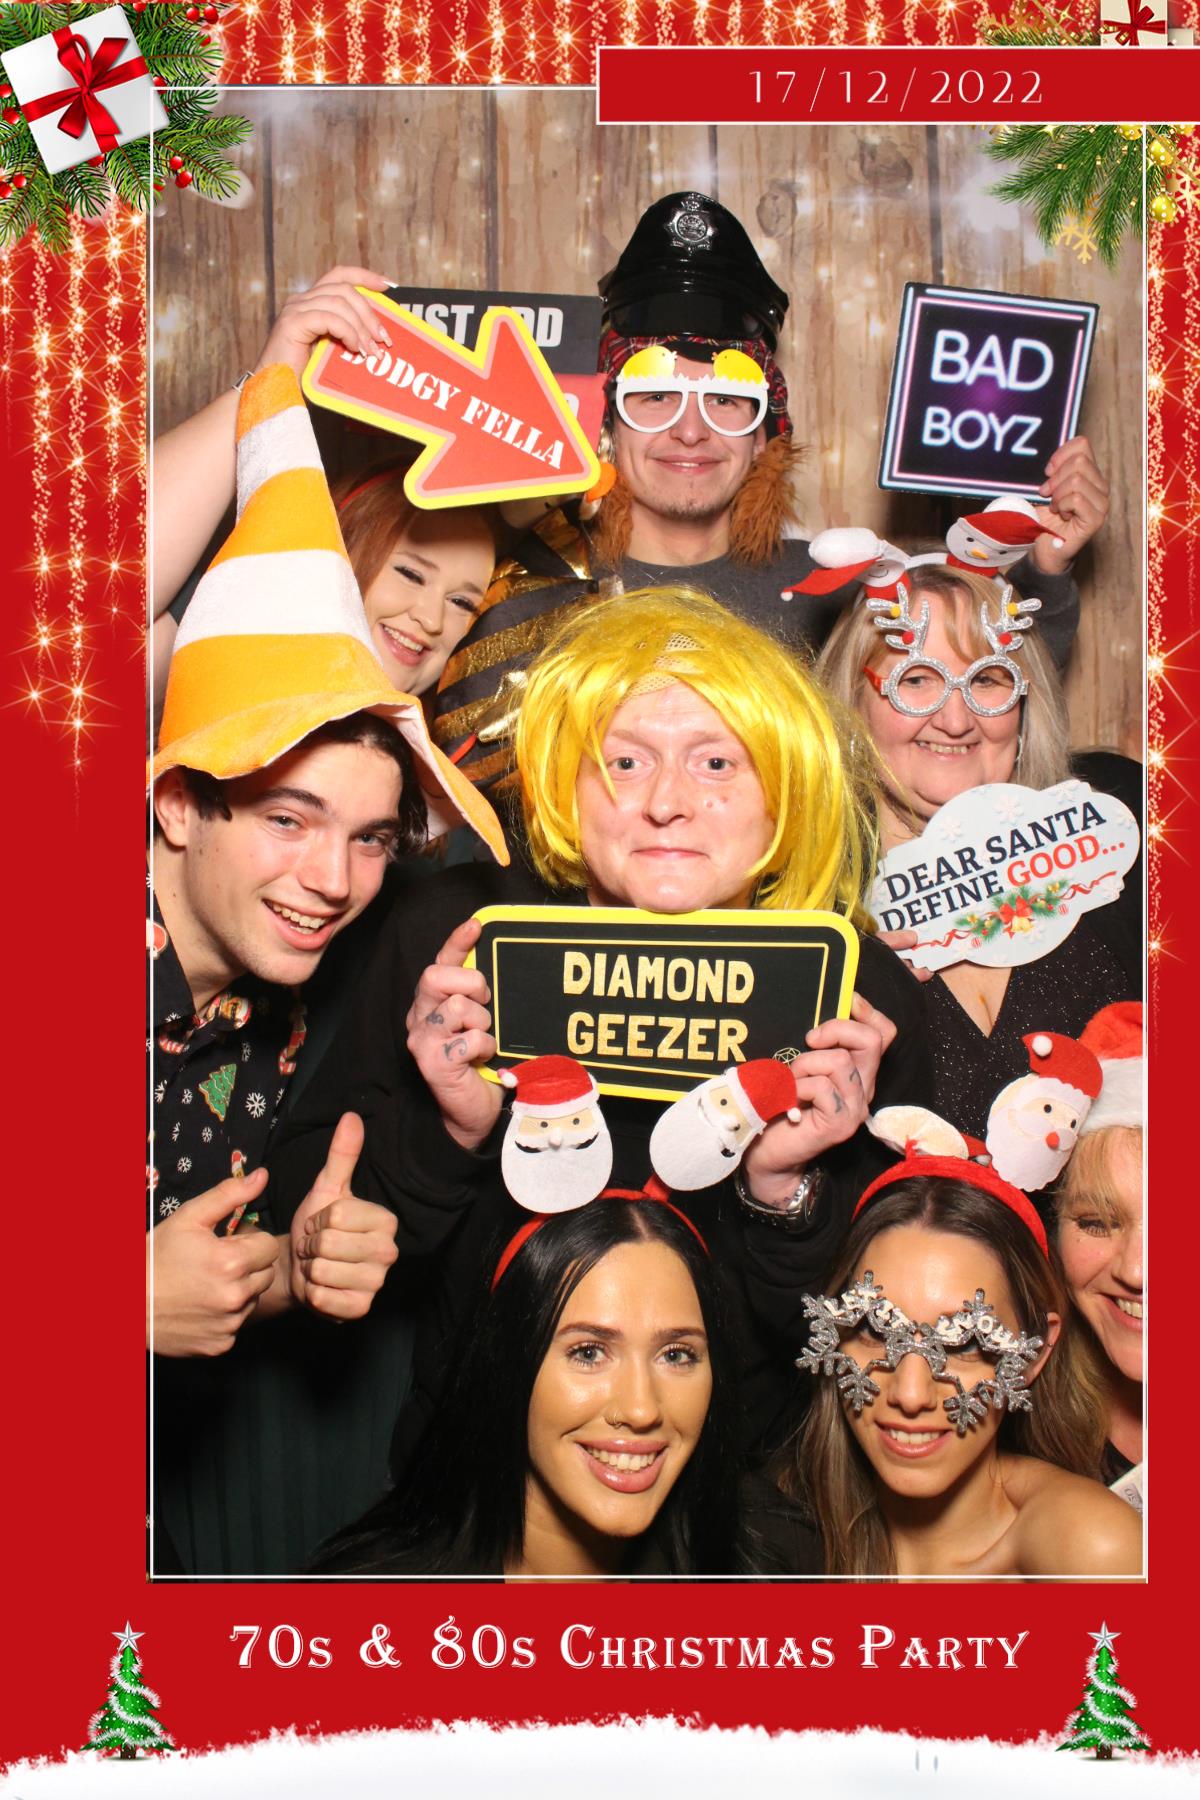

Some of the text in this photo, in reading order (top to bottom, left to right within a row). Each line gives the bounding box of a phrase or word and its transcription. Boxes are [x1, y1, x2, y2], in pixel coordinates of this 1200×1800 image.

[930, 329, 1054, 392] BAD
[461, 396, 565, 469] FELLA
[922, 406, 1042, 456] BOYZ
[879, 834, 1126, 932] DEFINE GOOD...
[883, 801, 1106, 904] DEAR SANTA
[563, 951, 755, 1004] DIAMOND
[567, 1011, 749, 1062] GEEZER
